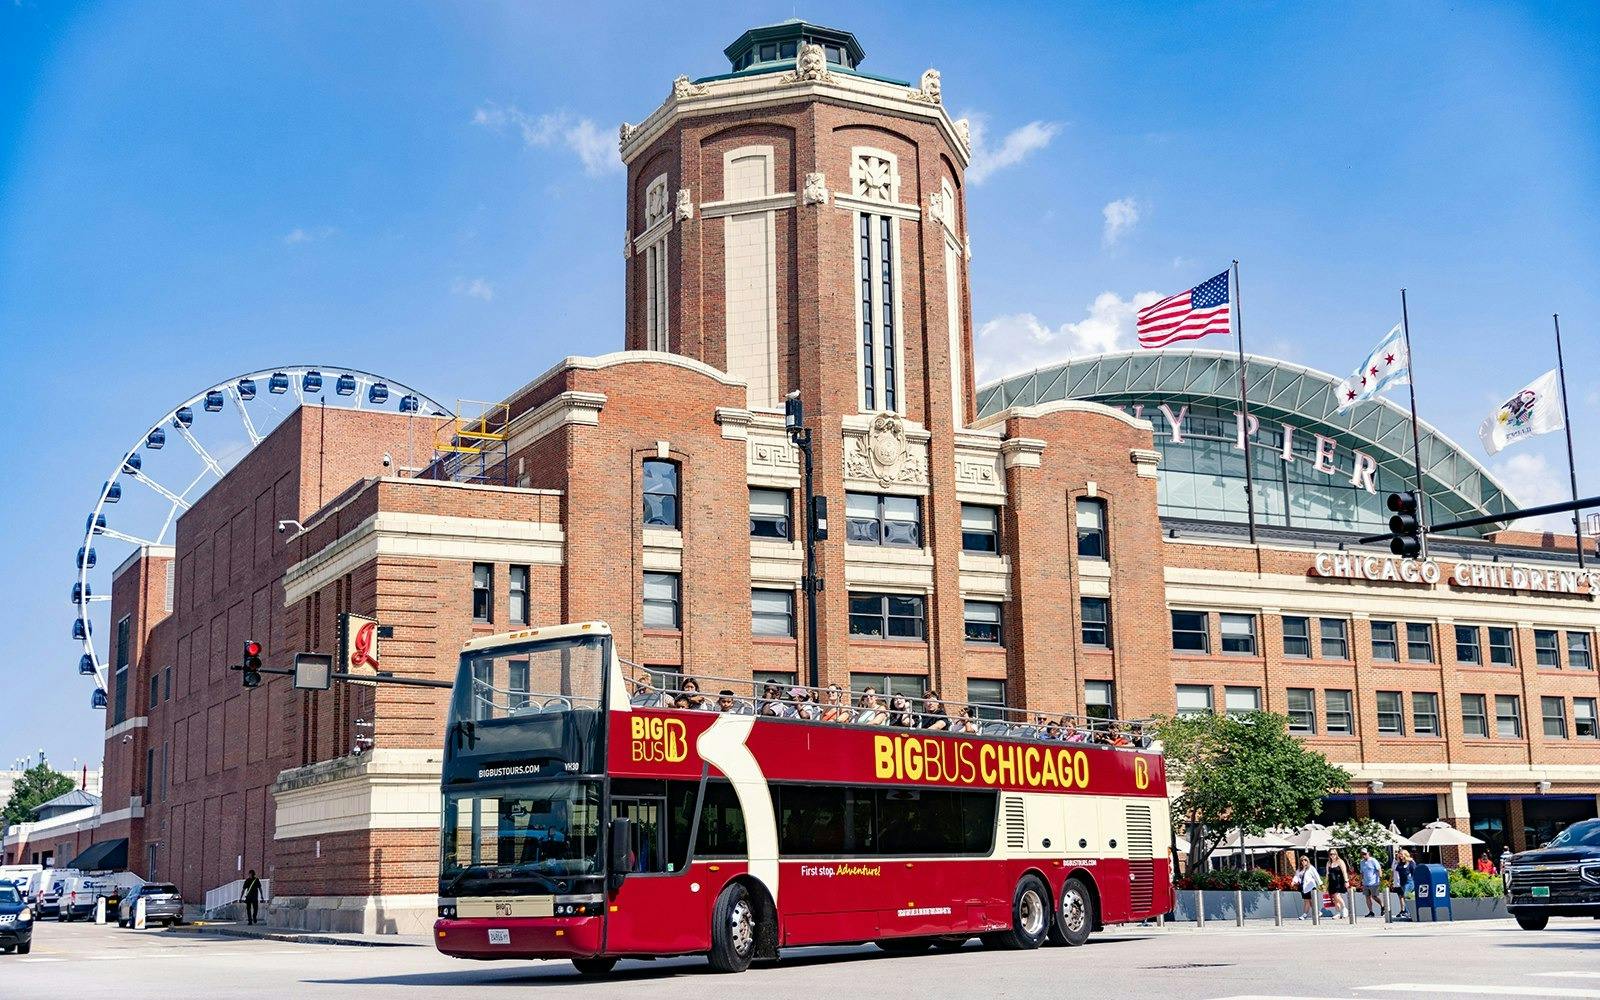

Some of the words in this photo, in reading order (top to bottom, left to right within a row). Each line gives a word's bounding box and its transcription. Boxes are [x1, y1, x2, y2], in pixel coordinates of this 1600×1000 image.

[1233, 411, 1377, 495] PIER
[1315, 552, 1441, 584] CHICAGO
[631, 716, 663, 740] BIG
[632, 741, 664, 761] BUS
[478, 764, 540, 778] BIGBUSTOURS.COM
[979, 744, 1089, 789] CHICAGO
[801, 865, 818, 876] First
[835, 863, 881, 876] Adventure!
